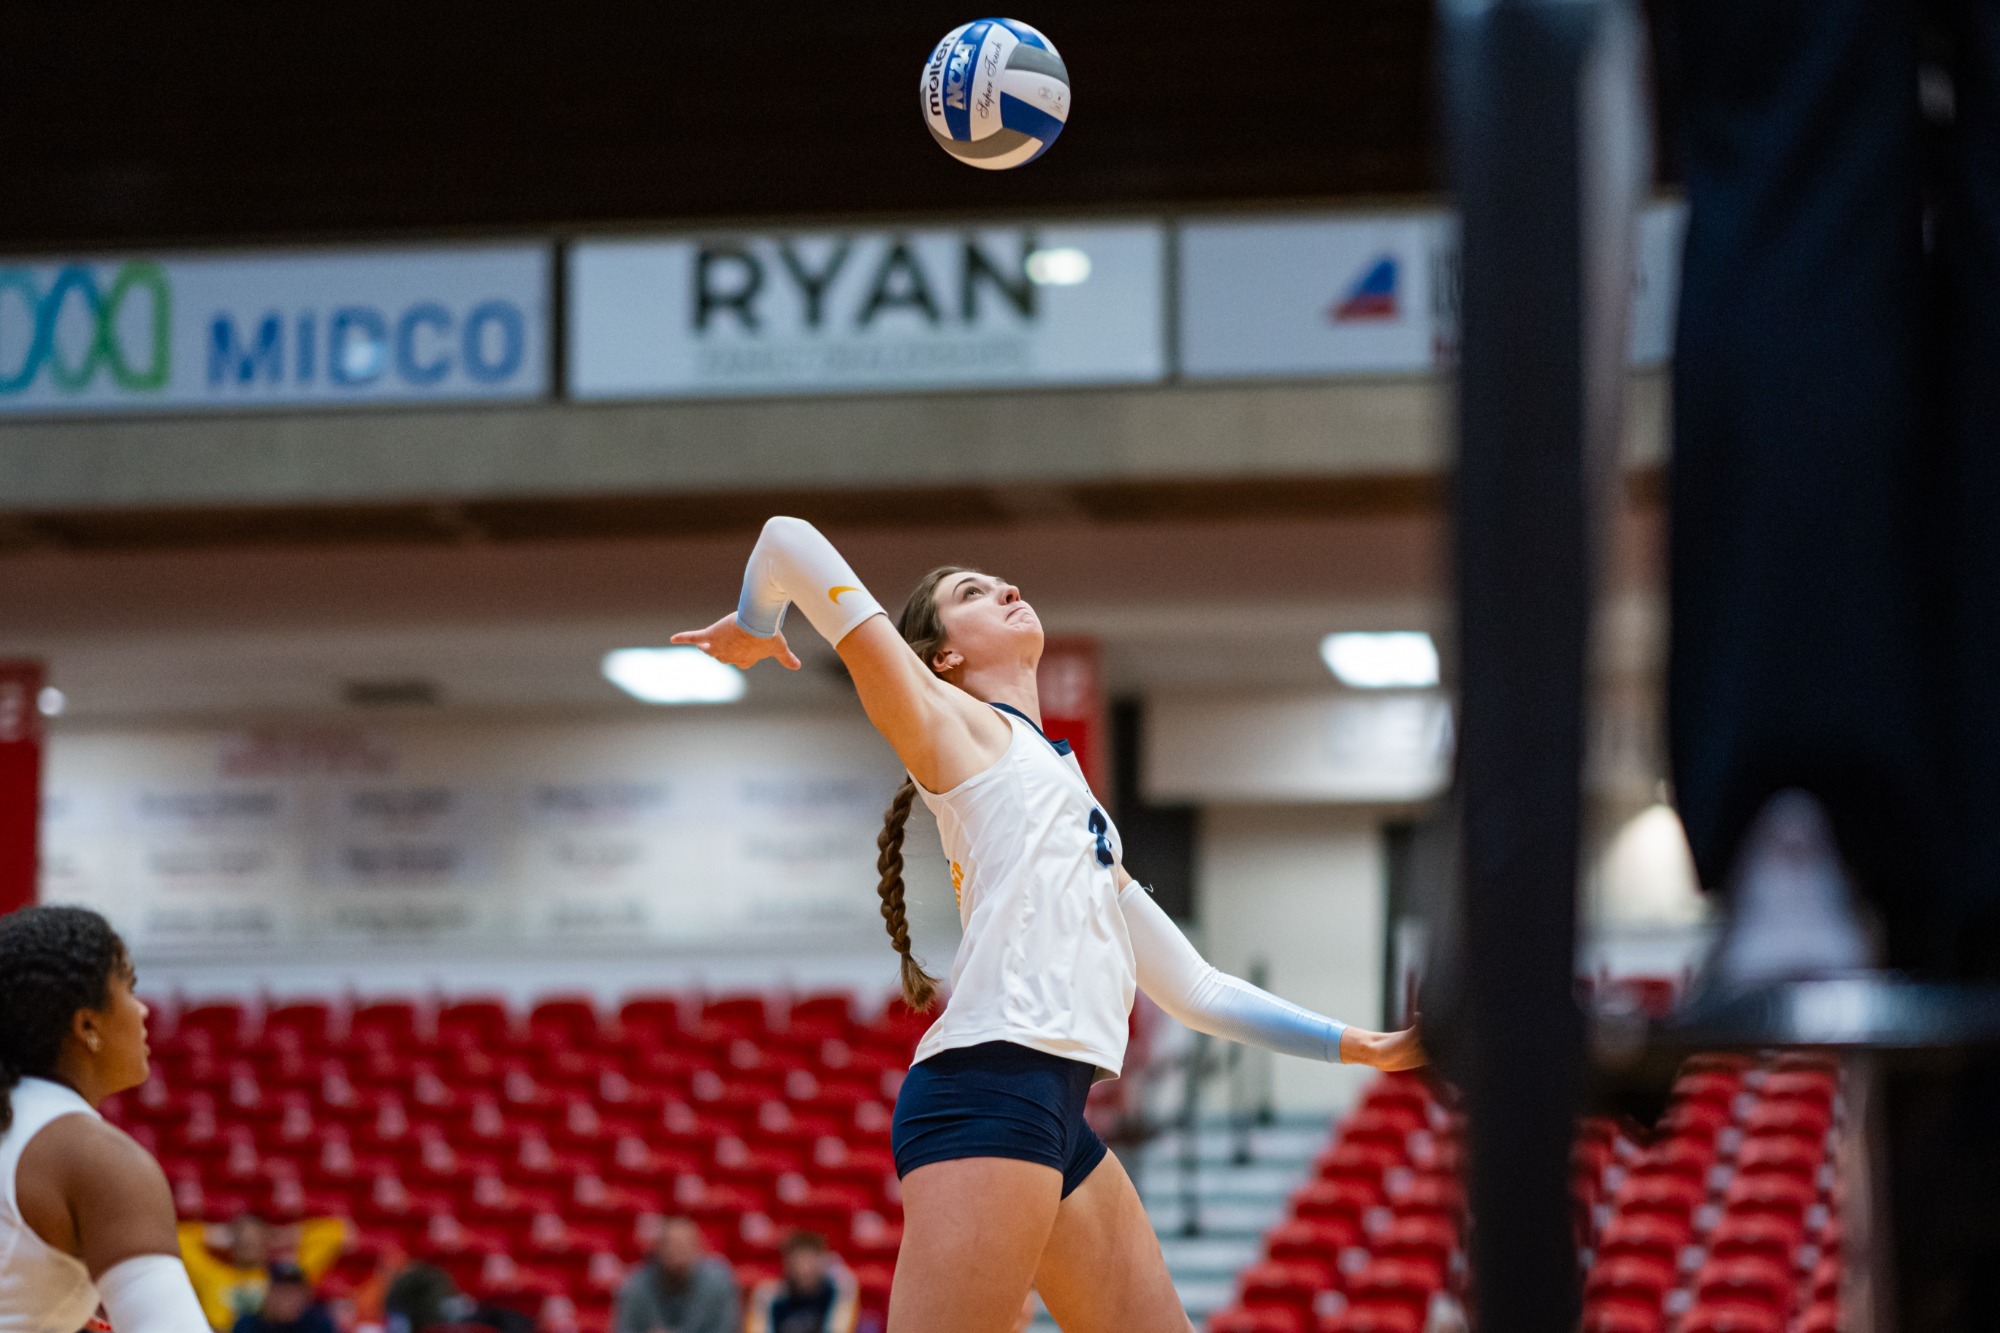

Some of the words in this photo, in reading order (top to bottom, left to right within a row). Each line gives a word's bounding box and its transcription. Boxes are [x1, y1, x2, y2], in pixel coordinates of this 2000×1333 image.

[946, 40, 976, 111] NCAA
[985, 41, 1002, 77] Touch
[976, 80, 995, 119] Super
[692, 232, 1040, 334] RYAN
[207, 300, 526, 388] MIDCO
